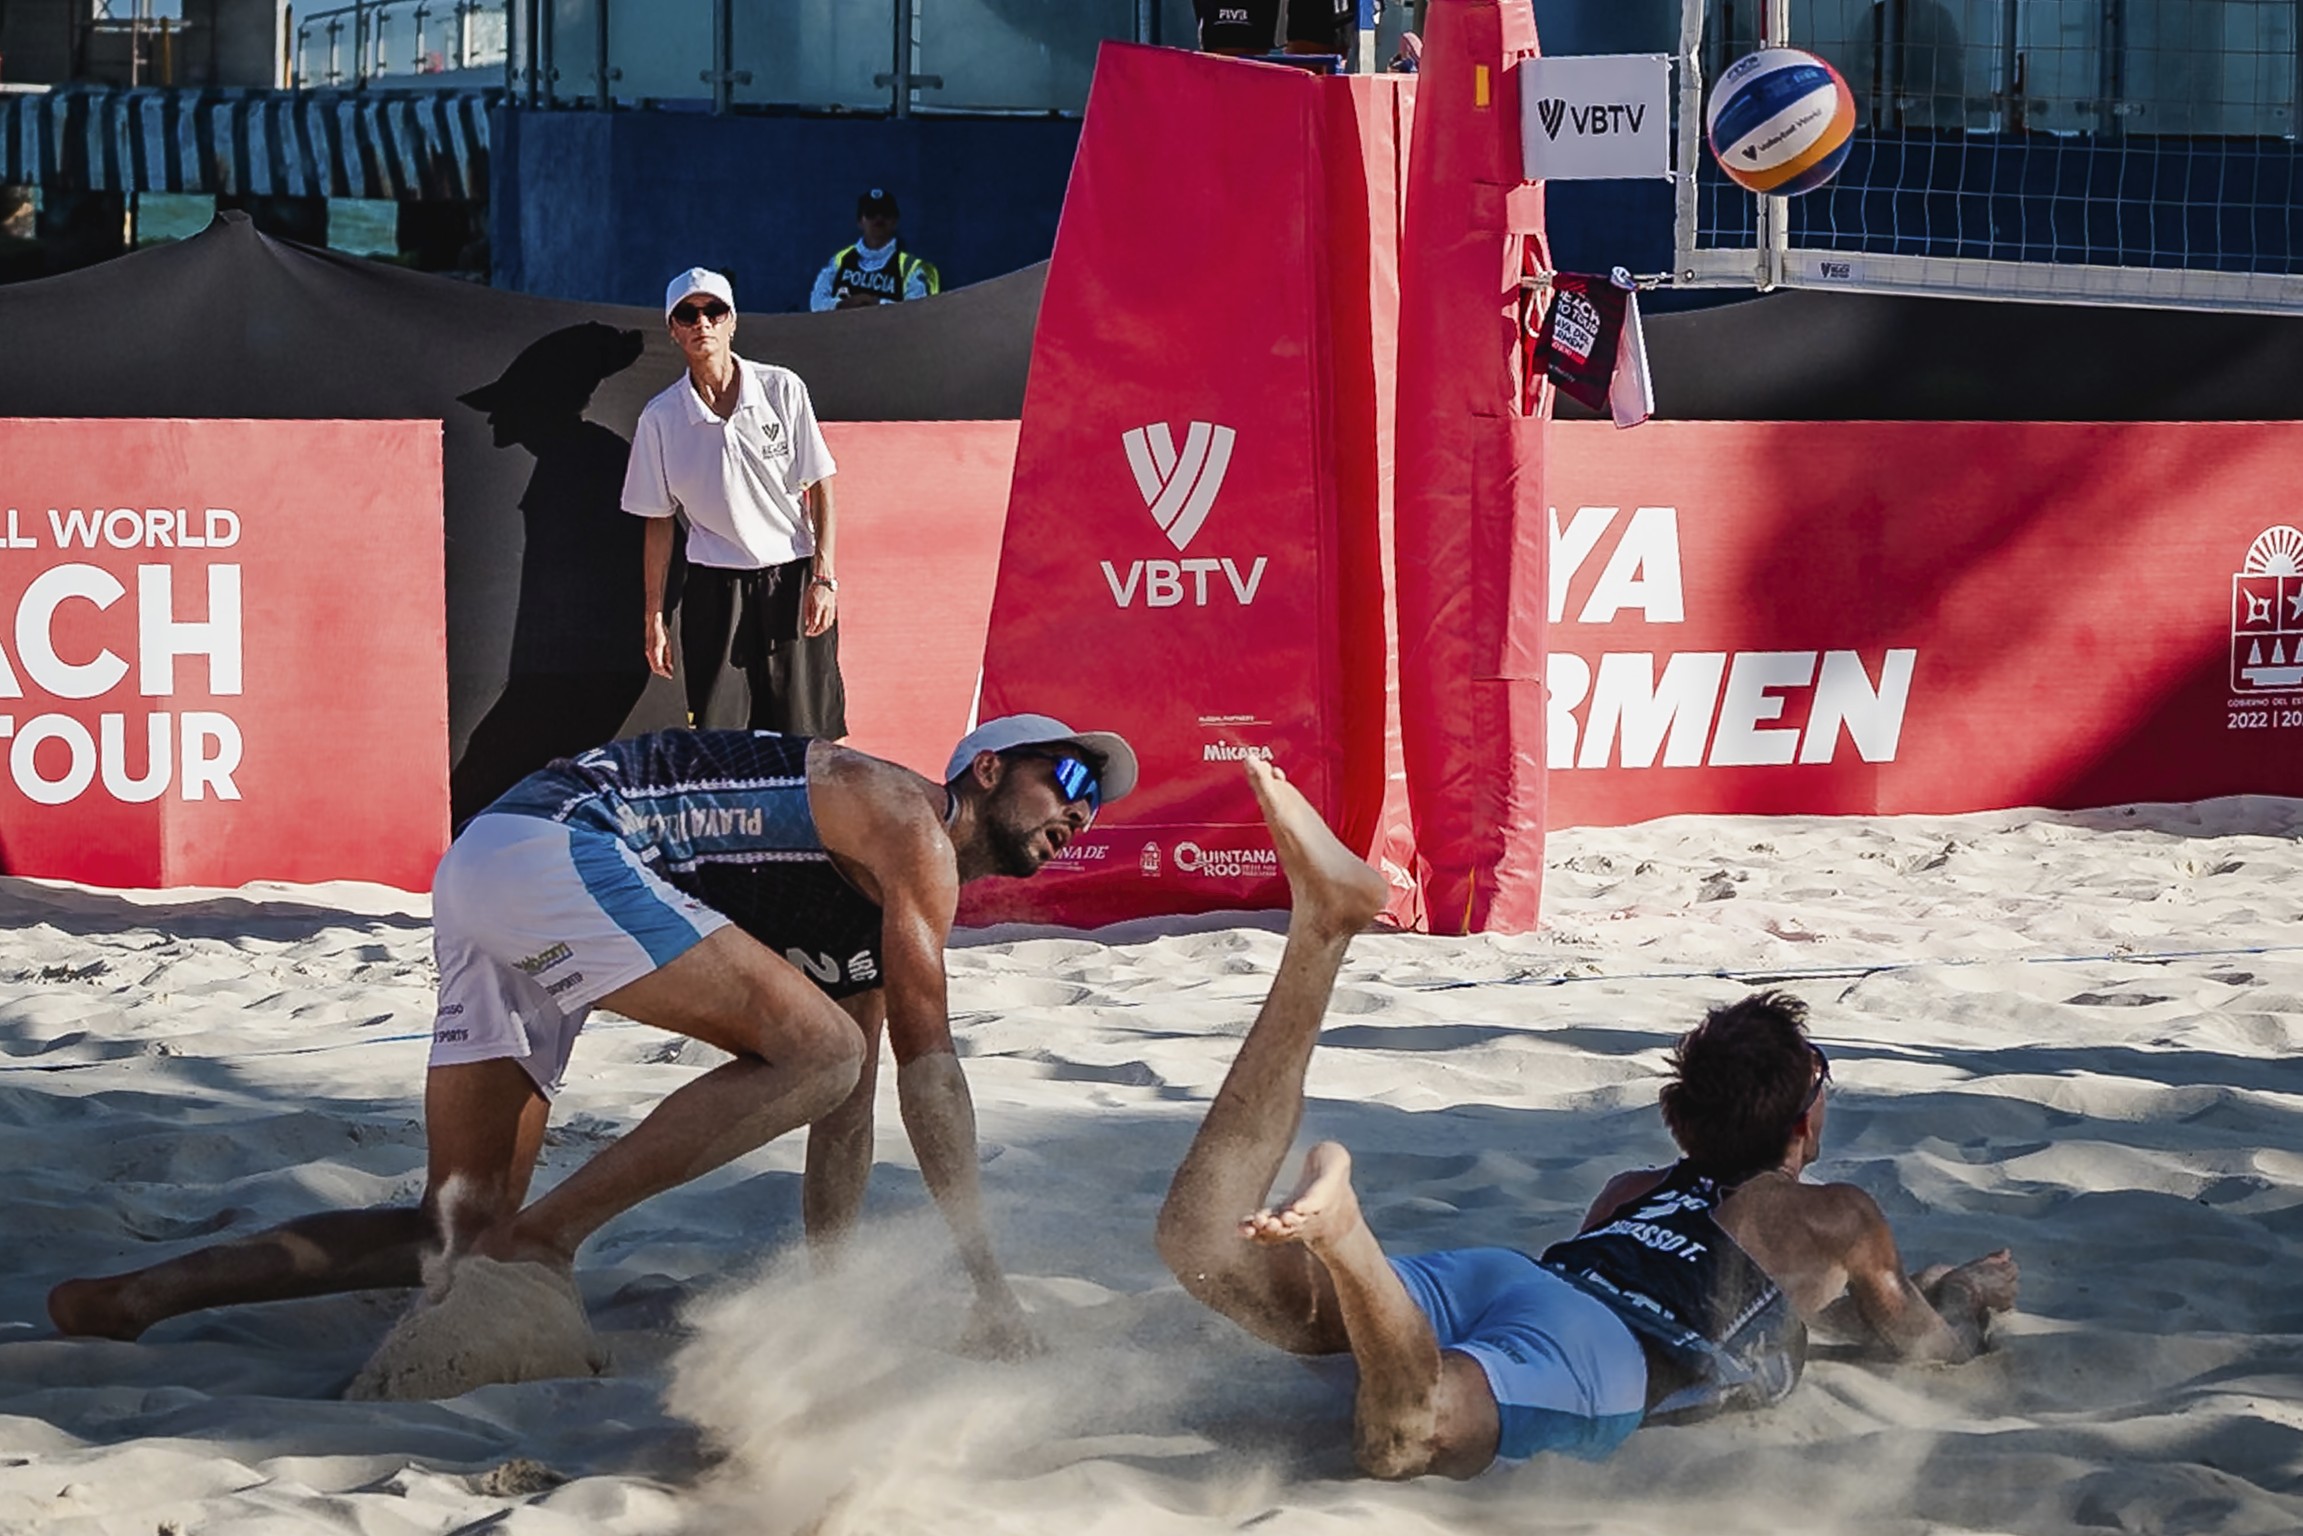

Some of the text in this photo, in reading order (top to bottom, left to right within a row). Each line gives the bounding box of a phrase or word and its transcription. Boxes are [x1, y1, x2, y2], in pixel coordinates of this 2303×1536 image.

[1570, 104, 1646, 135] VBTV
[0, 508, 241, 549] L WORLD
[1547, 505, 1686, 624] YA
[1100, 557, 1268, 608] VBTV
[1547, 648, 1918, 769] RMEN
[2227, 711, 2268, 729] 2022
[2281, 710, 2303, 727] 20
[690, 807, 763, 837] PLAYA
[1173, 841, 1277, 873] QUINTANA
[1204, 863, 1242, 878] ROO
